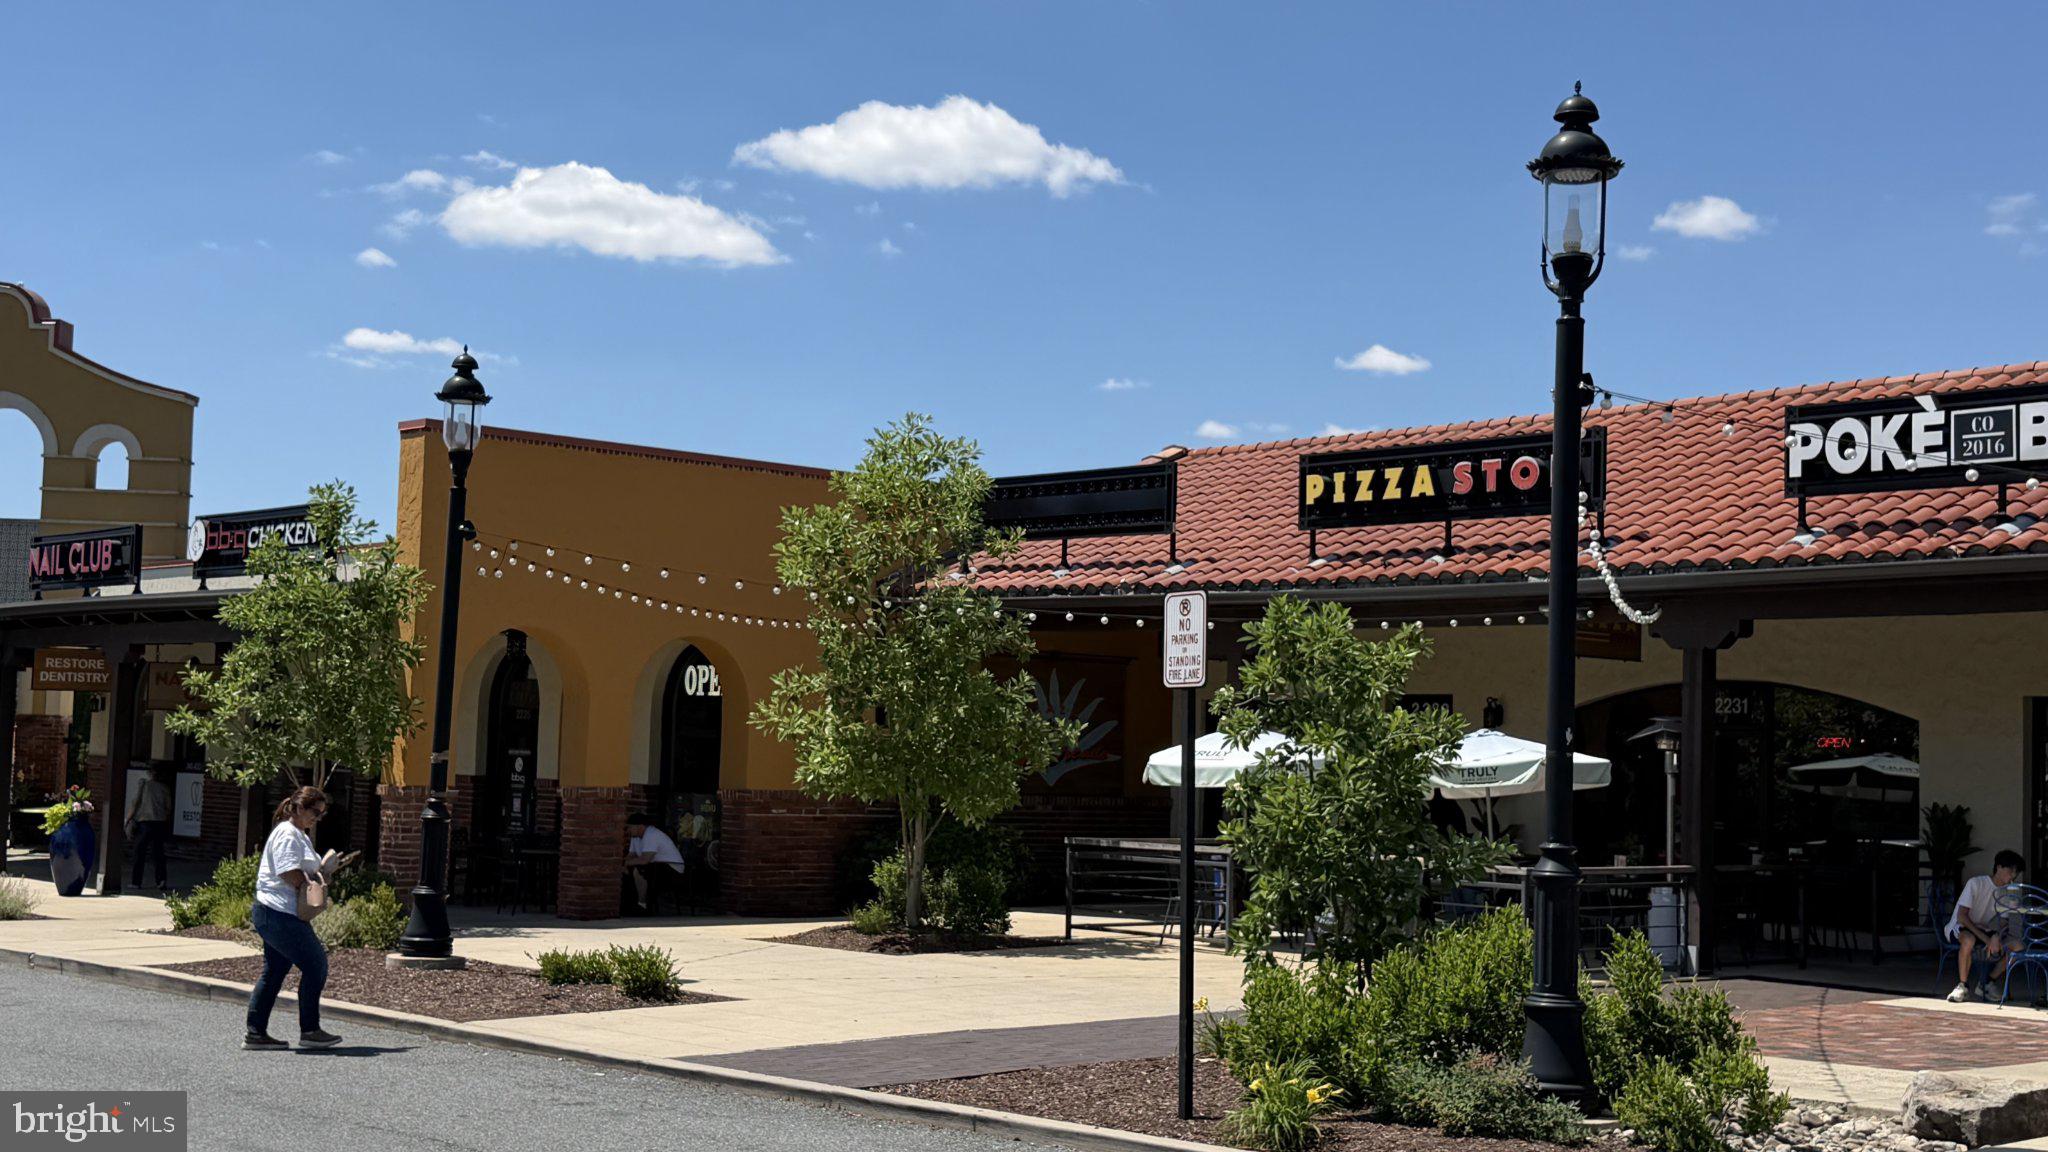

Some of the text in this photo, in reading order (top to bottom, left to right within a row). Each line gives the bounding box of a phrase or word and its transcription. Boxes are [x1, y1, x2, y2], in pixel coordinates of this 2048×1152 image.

[1971, 415, 1995, 433] CO
[1962, 437, 2005, 457] 2016
[1305, 455, 1554, 506] PIZZA STO
[247, 522, 317, 549] CHCKEN
[28, 539, 112, 577] NAIL CLUB
[1179, 618, 1191, 632] NO
[1171, 633, 1199, 645] PARKING
[45, 657, 105, 669] RESTORE
[1168, 655, 1201, 667] STANDING
[39, 671, 110, 683] DENTISTRY
[684, 664, 723, 697] OPE
[1168, 668, 1201, 680] FIRE LANE
[1715, 697, 1748, 715] 2231
[1816, 737, 1852, 749] OPEN
[1195, 749, 1232, 757] RULY
[1460, 765, 1499, 778] TRULY
